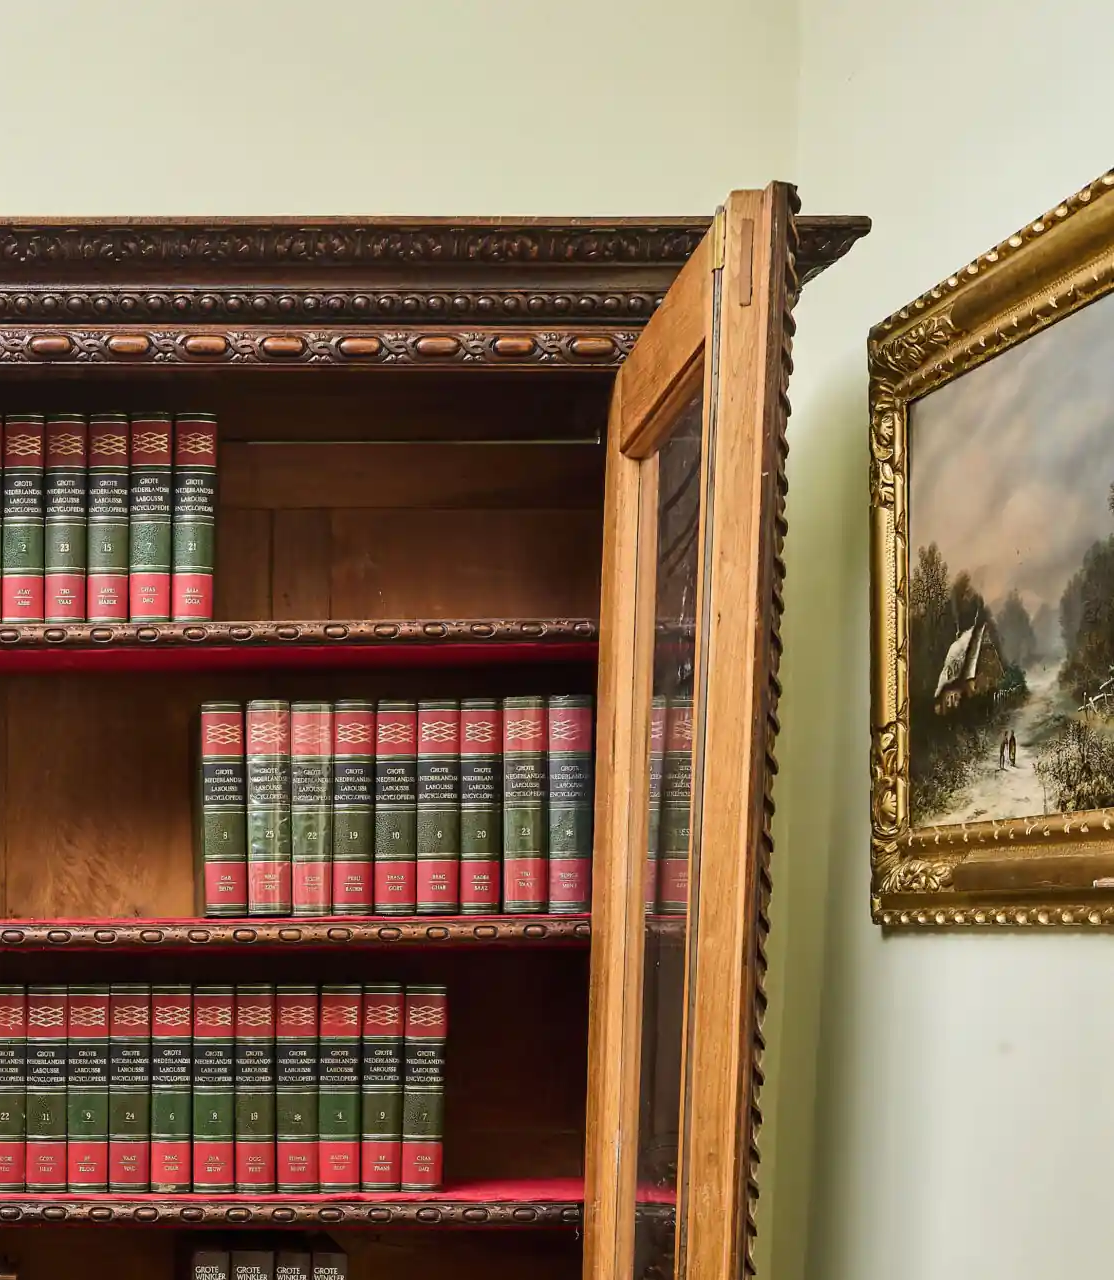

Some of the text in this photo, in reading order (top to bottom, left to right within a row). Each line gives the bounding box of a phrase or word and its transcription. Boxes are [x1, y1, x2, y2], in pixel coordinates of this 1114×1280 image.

[60, 544, 69, 552] 23
[103, 544, 112, 552] 15
[437, 831, 442, 839] 6
[126, 1112, 135, 1120] 24
[196, 1273, 226, 1280] WINKLER
